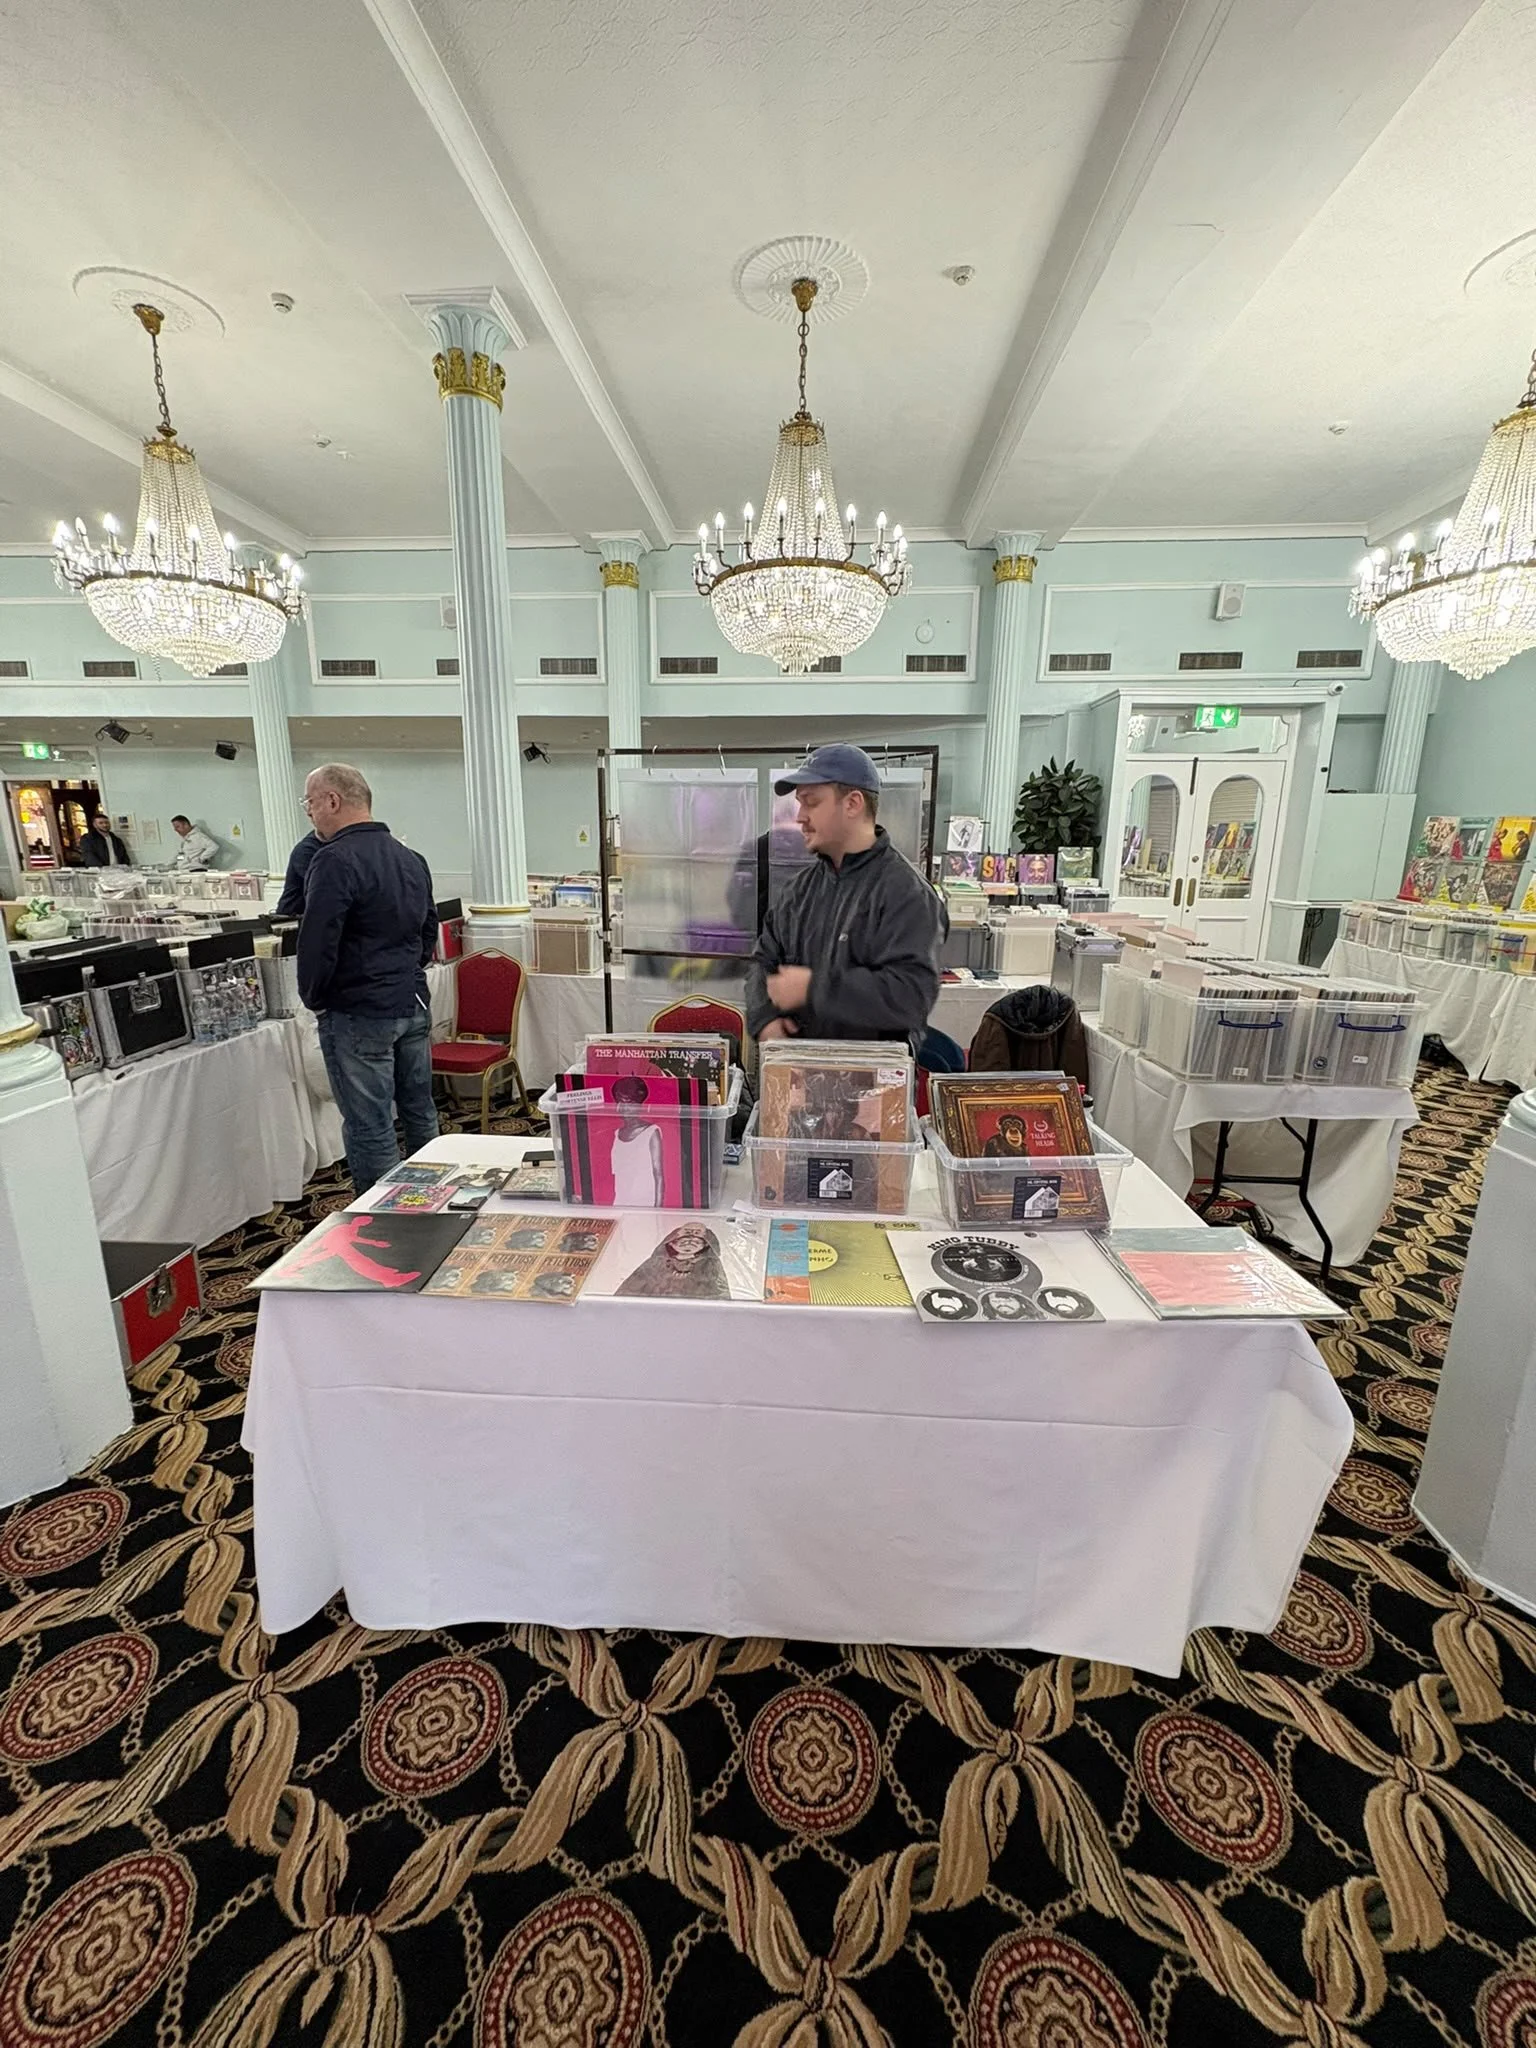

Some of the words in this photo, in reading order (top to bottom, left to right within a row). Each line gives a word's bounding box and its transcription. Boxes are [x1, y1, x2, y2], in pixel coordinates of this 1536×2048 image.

[595, 1049, 612, 1058] THE
[615, 1050, 667, 1059] MANHATTAN
[669, 1051, 713, 1061] TRANSFER
[1030, 1132, 1056, 1140] TALKING
[568, 1218, 592, 1228] PETER
[927, 1236, 962, 1251] KING
[487, 1252, 512, 1264] PETER
[511, 1253, 538, 1265] TOSH
[543, 1255, 569, 1267] PETER
[568, 1257, 593, 1268] TOSH
